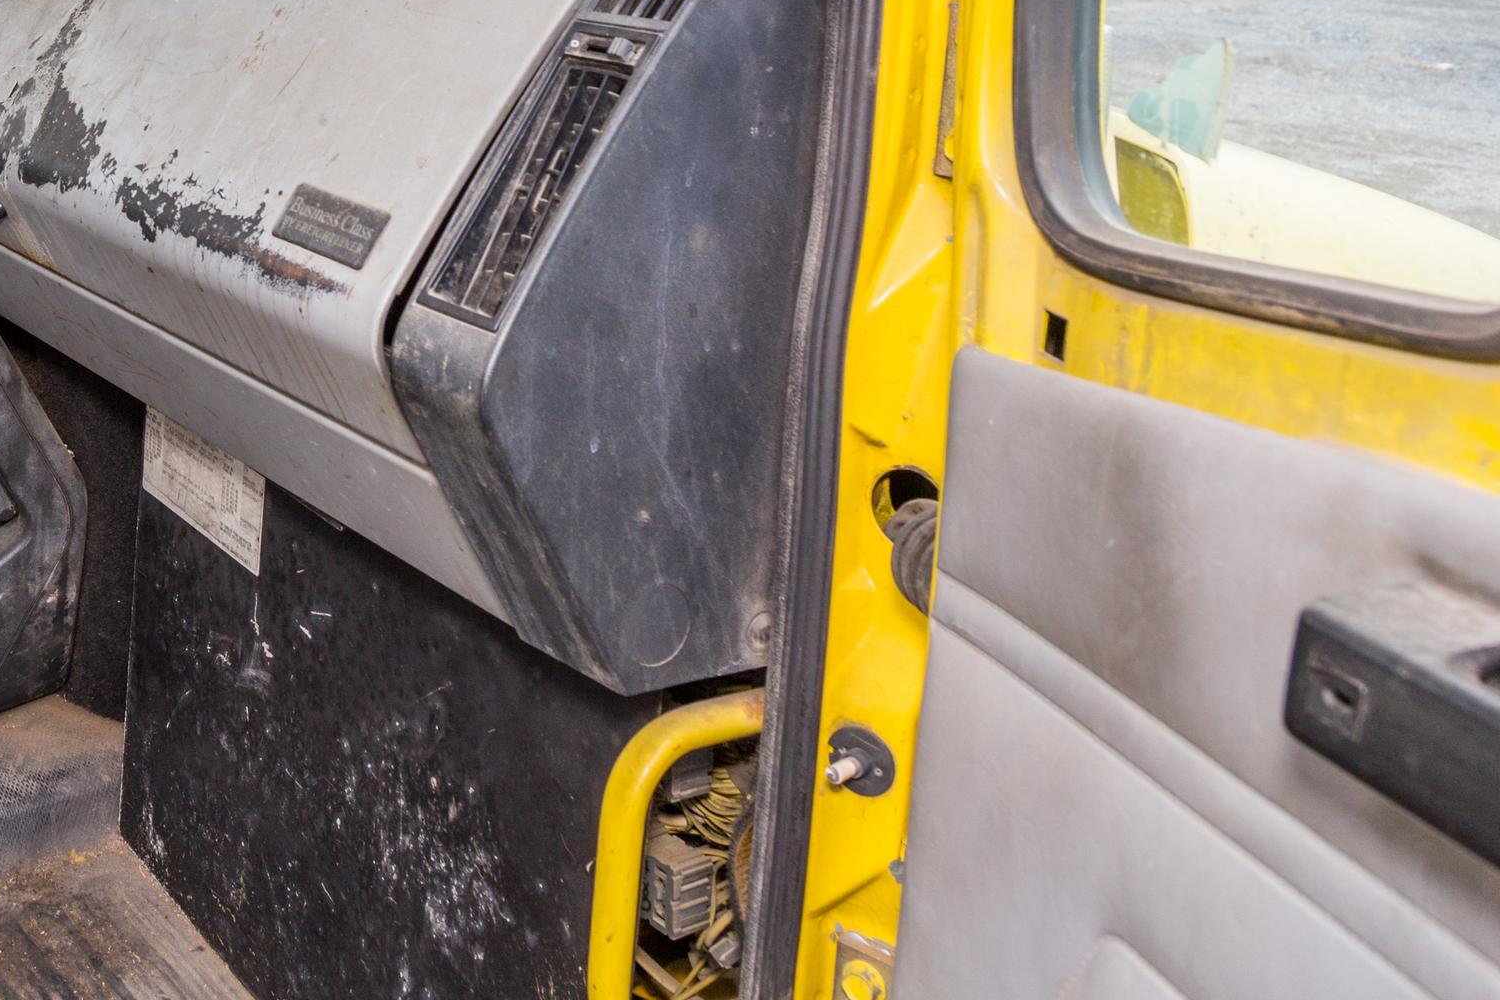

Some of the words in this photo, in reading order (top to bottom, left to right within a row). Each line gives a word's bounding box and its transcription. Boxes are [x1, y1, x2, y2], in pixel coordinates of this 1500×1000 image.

[290, 196, 341, 227] Business
[341, 214, 375, 241] Class
[295, 222, 364, 254] FREIGHTLINER
